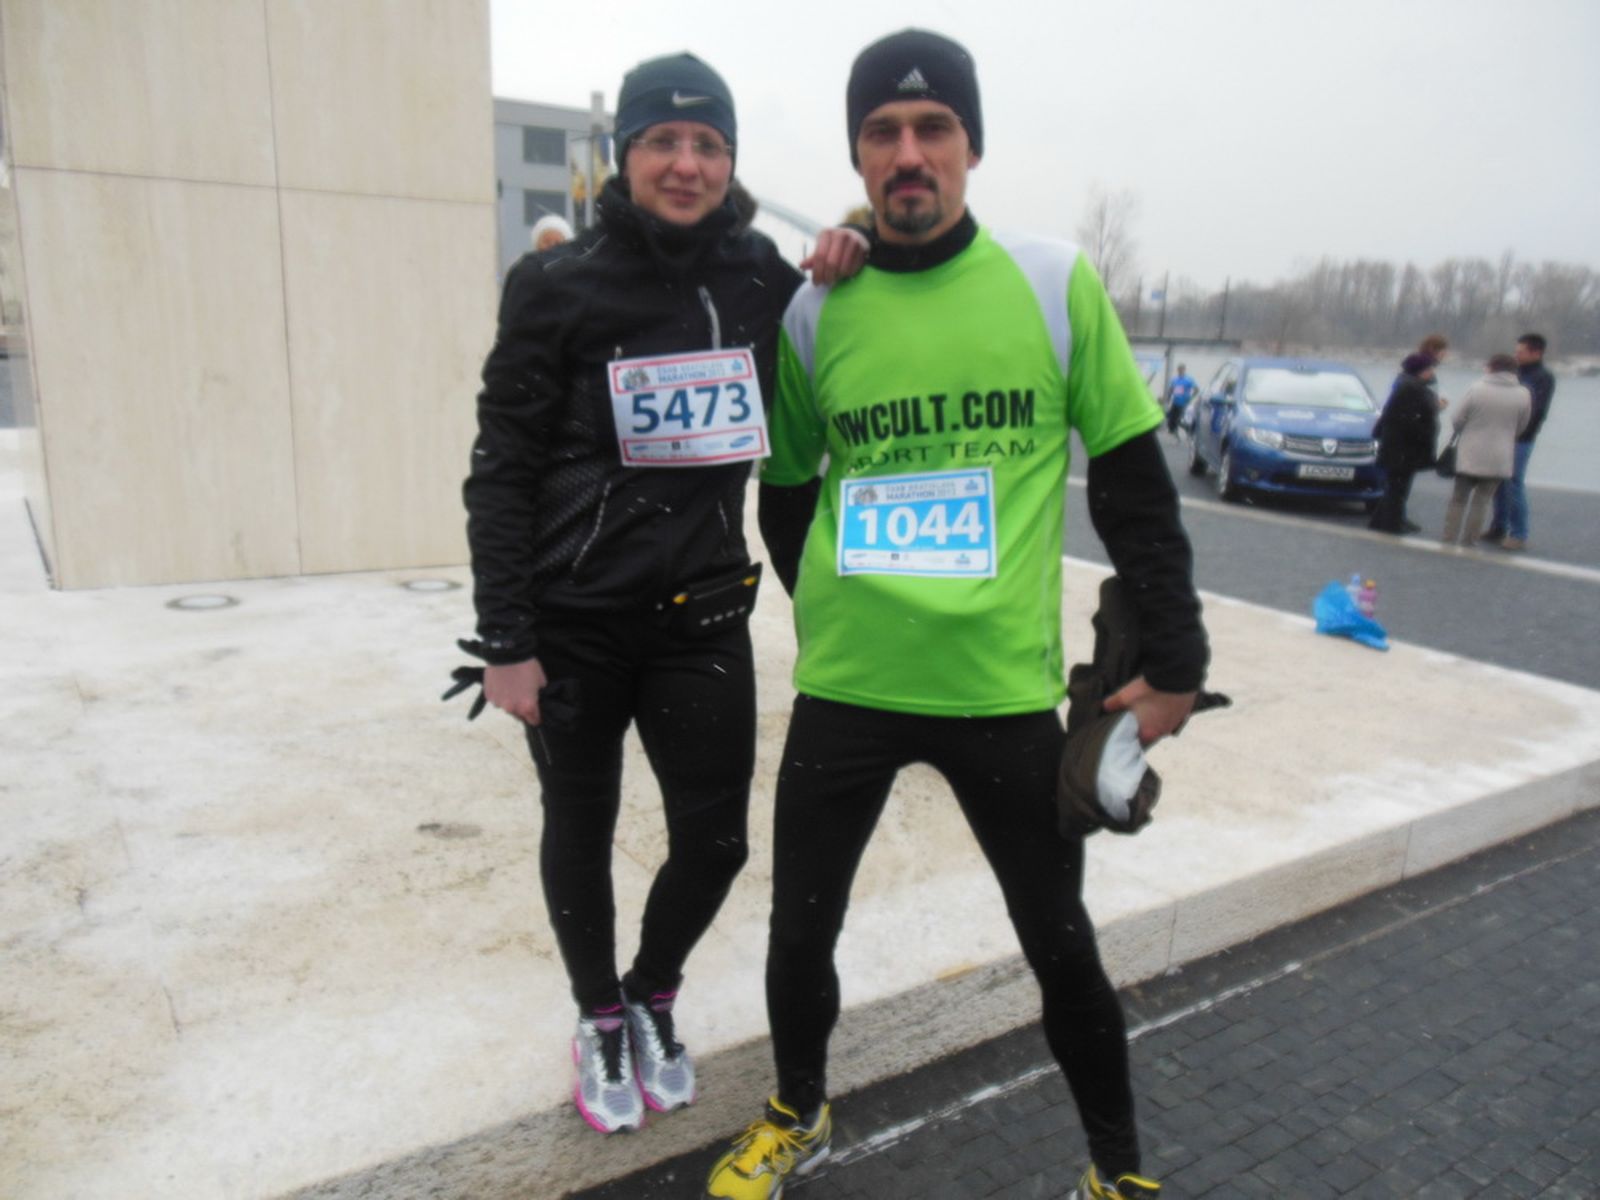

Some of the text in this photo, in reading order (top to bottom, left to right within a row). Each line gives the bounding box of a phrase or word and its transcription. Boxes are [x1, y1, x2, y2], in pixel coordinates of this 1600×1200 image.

[631, 381, 751, 434] 5473
[848, 437, 1035, 471] PORT TEAM
[857, 501, 984, 546] 1044
